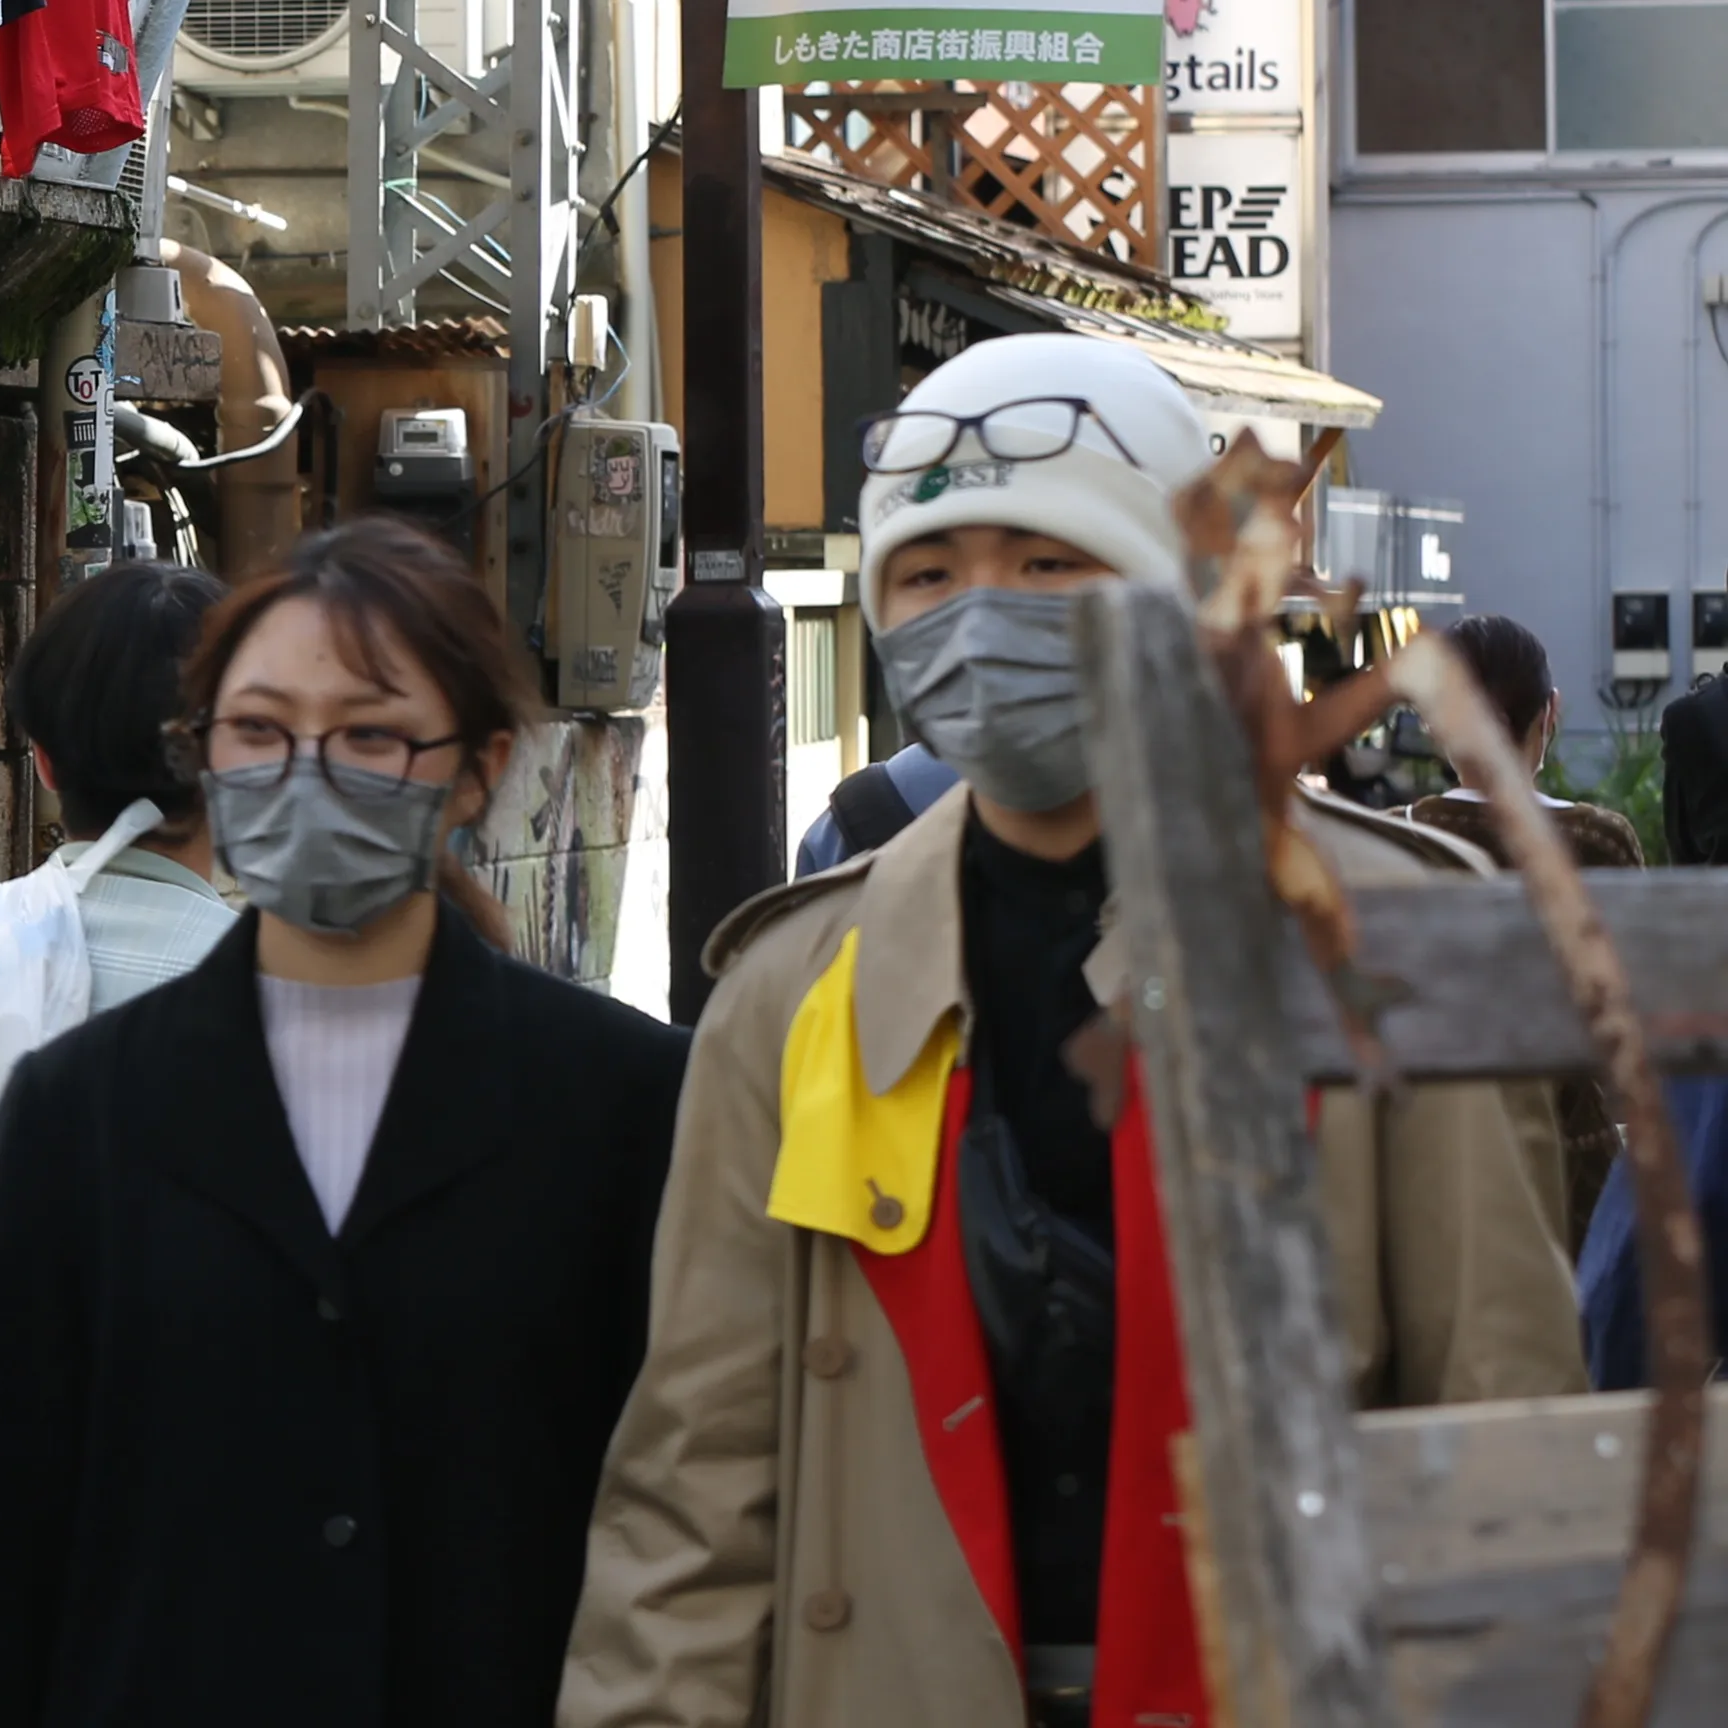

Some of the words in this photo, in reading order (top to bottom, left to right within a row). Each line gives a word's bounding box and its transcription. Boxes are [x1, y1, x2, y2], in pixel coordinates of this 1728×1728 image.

[774, 28, 1105, 65] しもきた商店街振興組合
